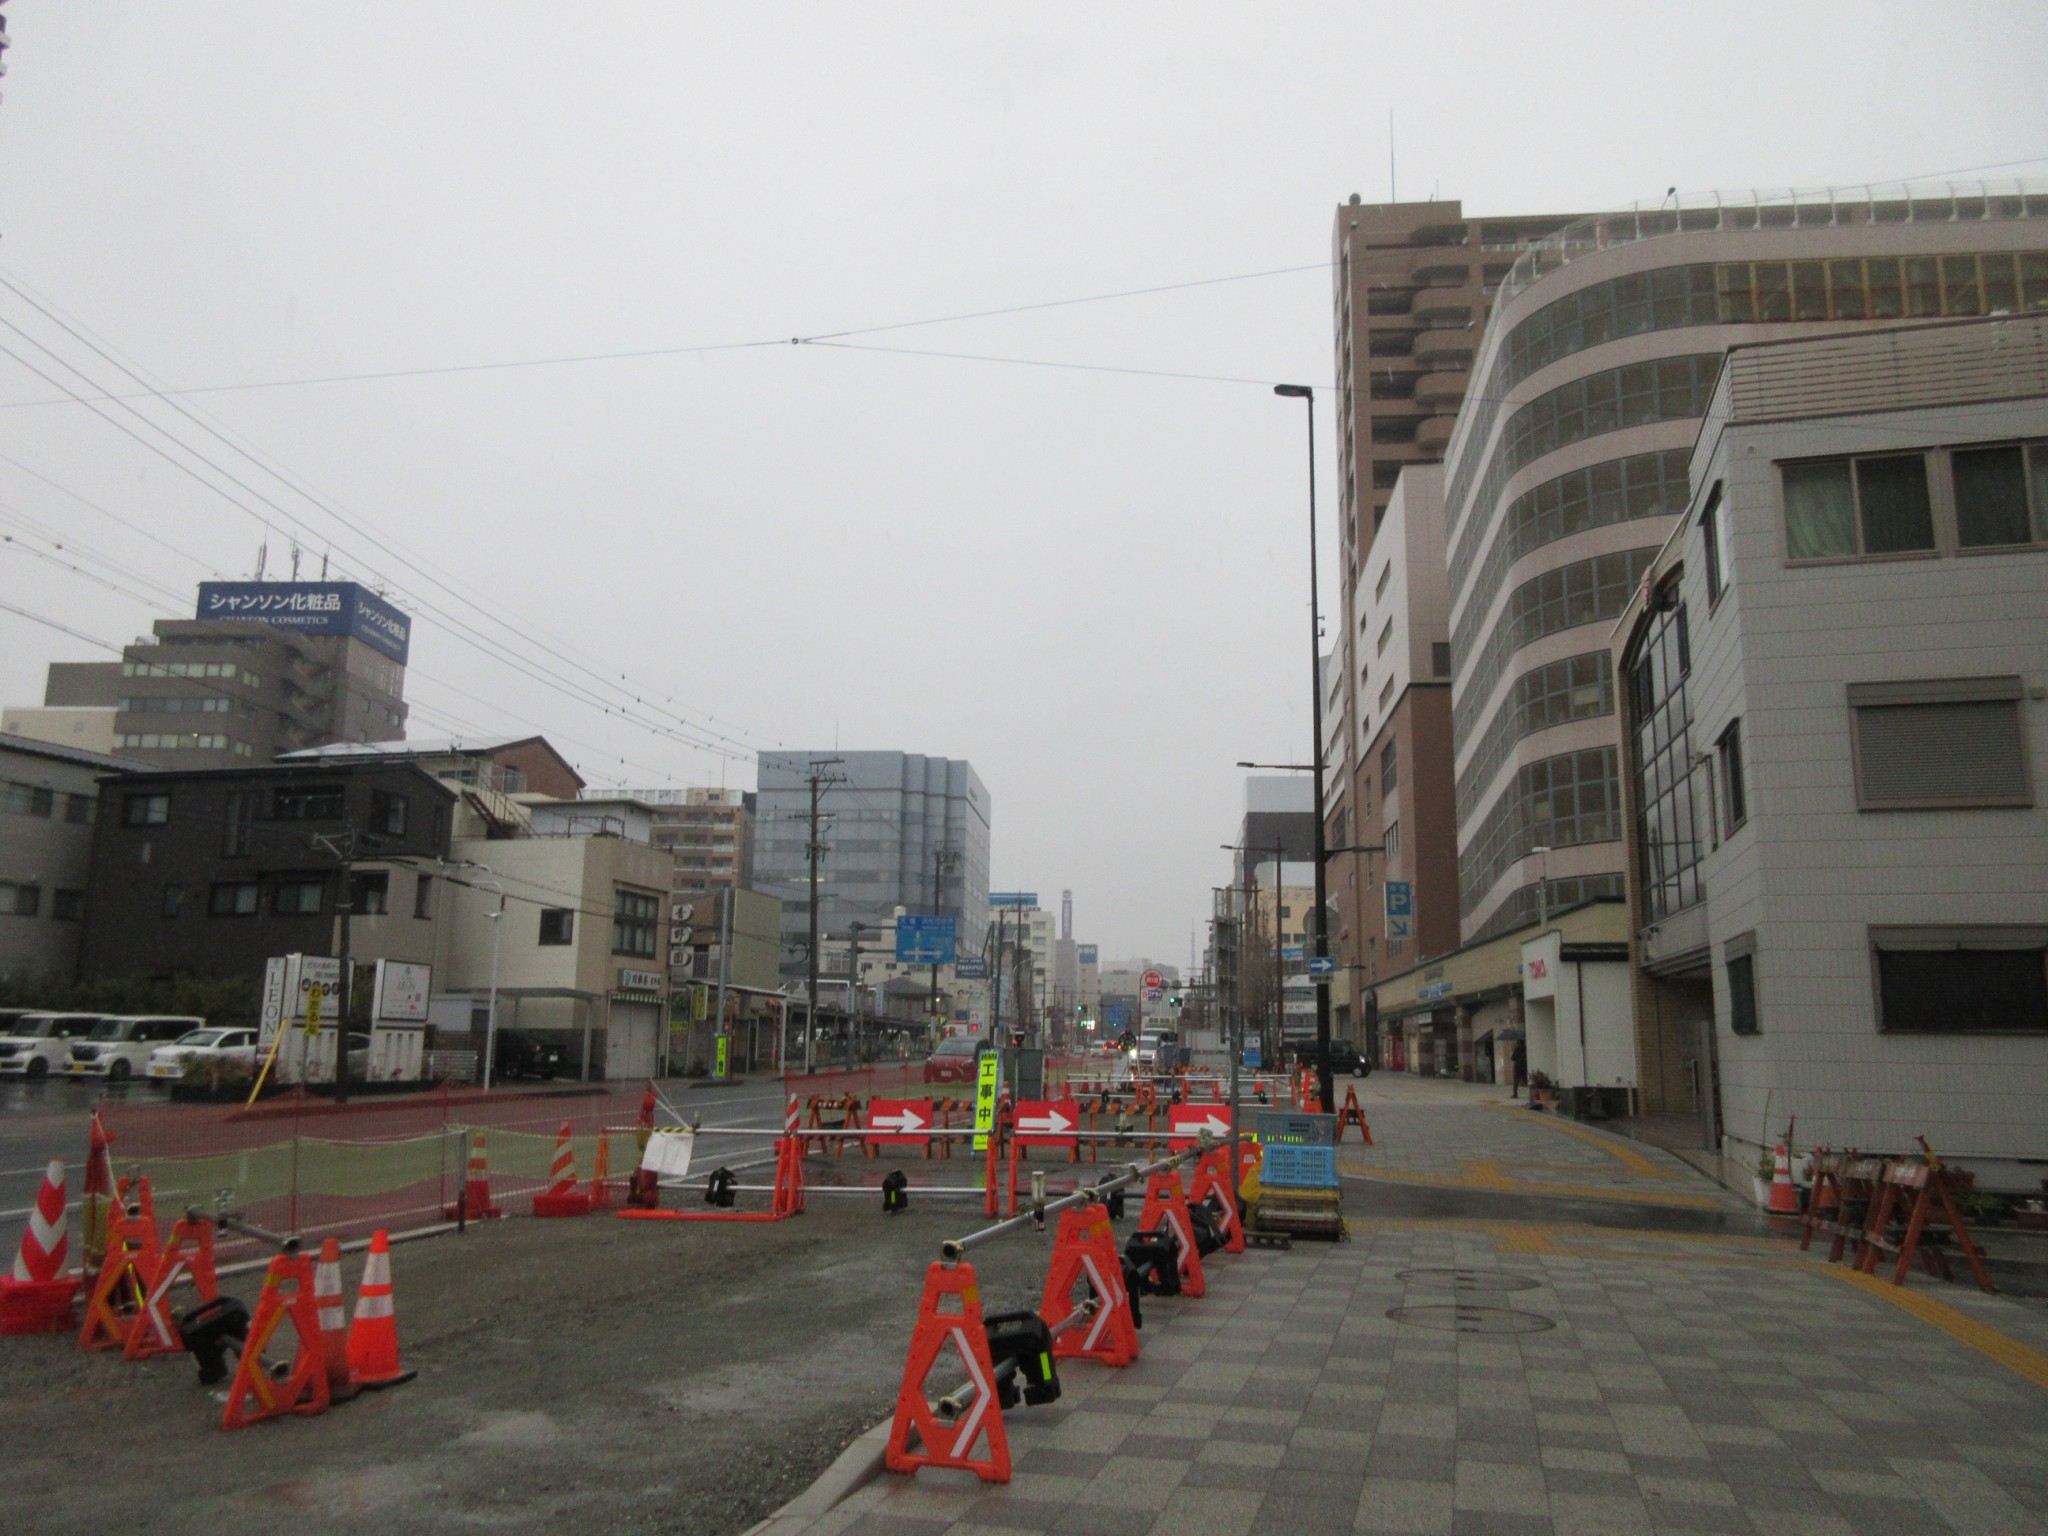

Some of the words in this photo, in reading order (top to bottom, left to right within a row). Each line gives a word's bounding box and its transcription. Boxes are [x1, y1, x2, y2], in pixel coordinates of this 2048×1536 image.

[209, 593, 342, 611] シャンソン化粧品
[271, 615, 329, 625] COSMETICS
[358, 601, 406, 641] シャンソン化粧品
[1391, 893, 1407, 911] P
[264, 972, 279, 1035] LEON
[978, 1063, 994, 1122] 工事中
